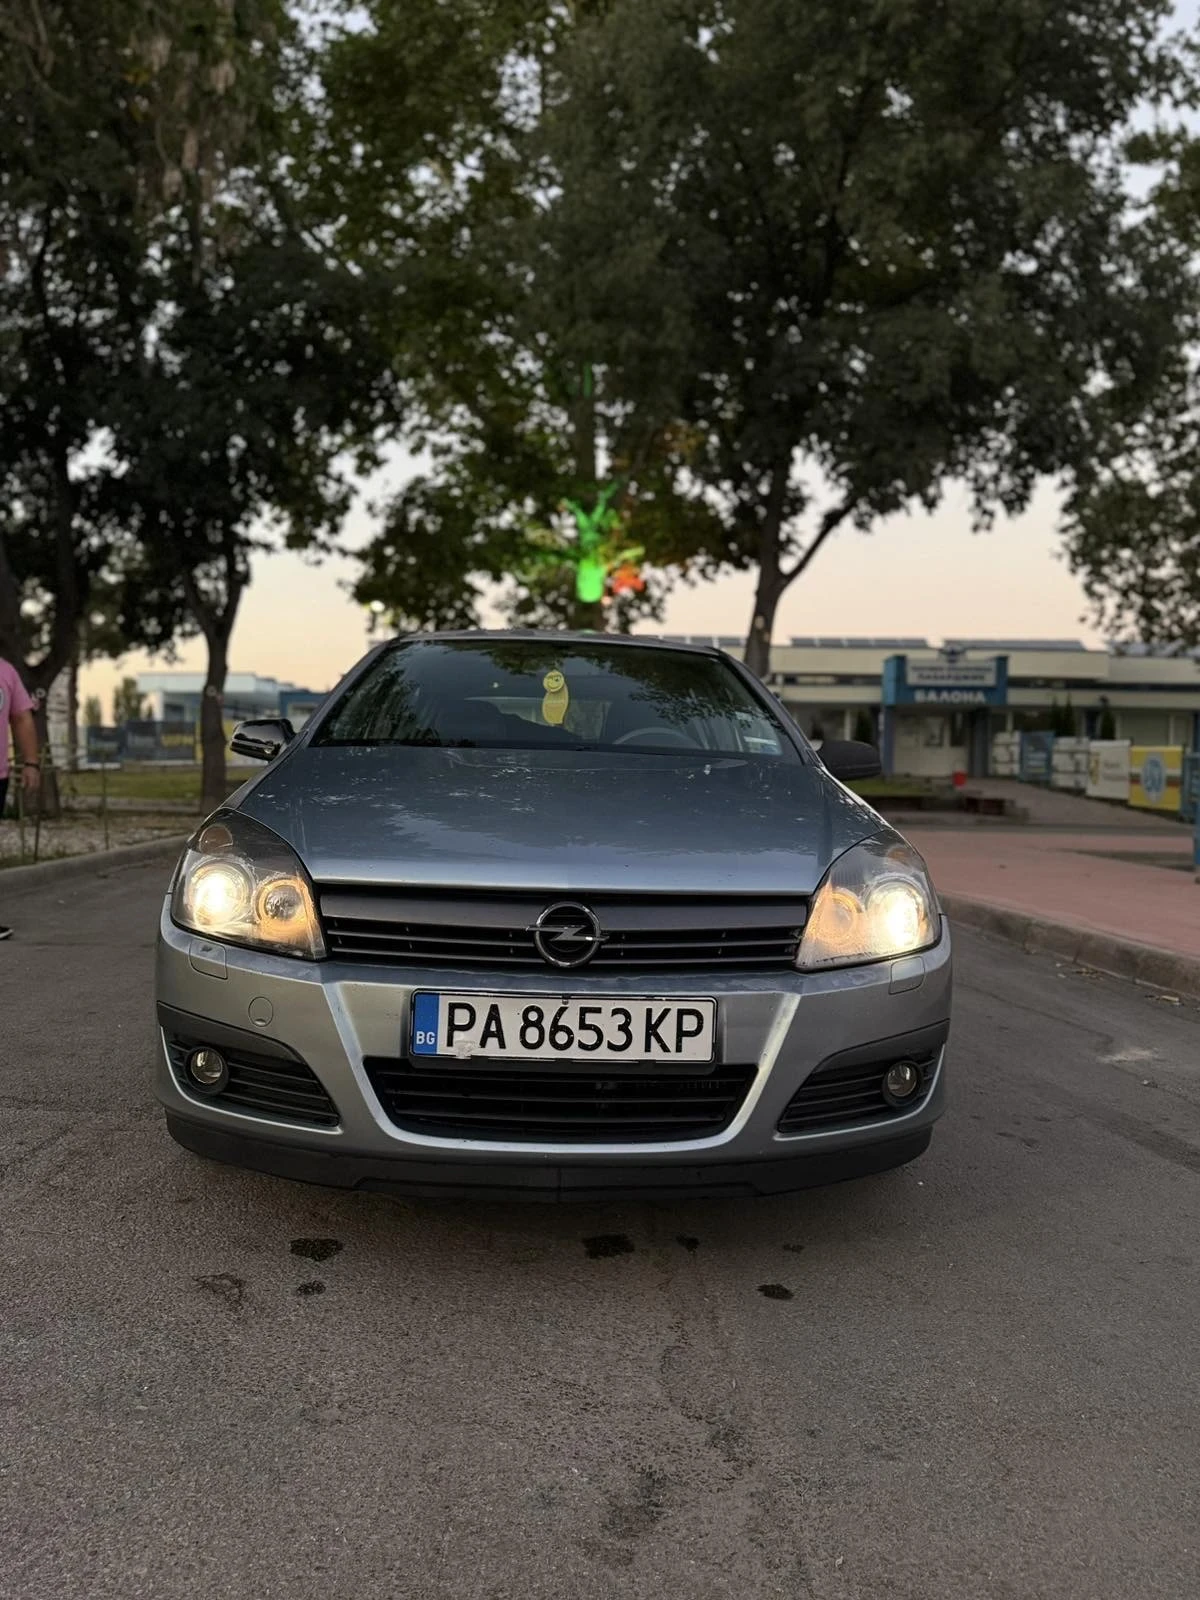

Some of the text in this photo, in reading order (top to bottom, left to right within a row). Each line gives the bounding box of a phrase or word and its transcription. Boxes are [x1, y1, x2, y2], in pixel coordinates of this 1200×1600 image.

[416, 1030, 436, 1046] BG
[446, 1002, 704, 1054] PA 8653 KP
